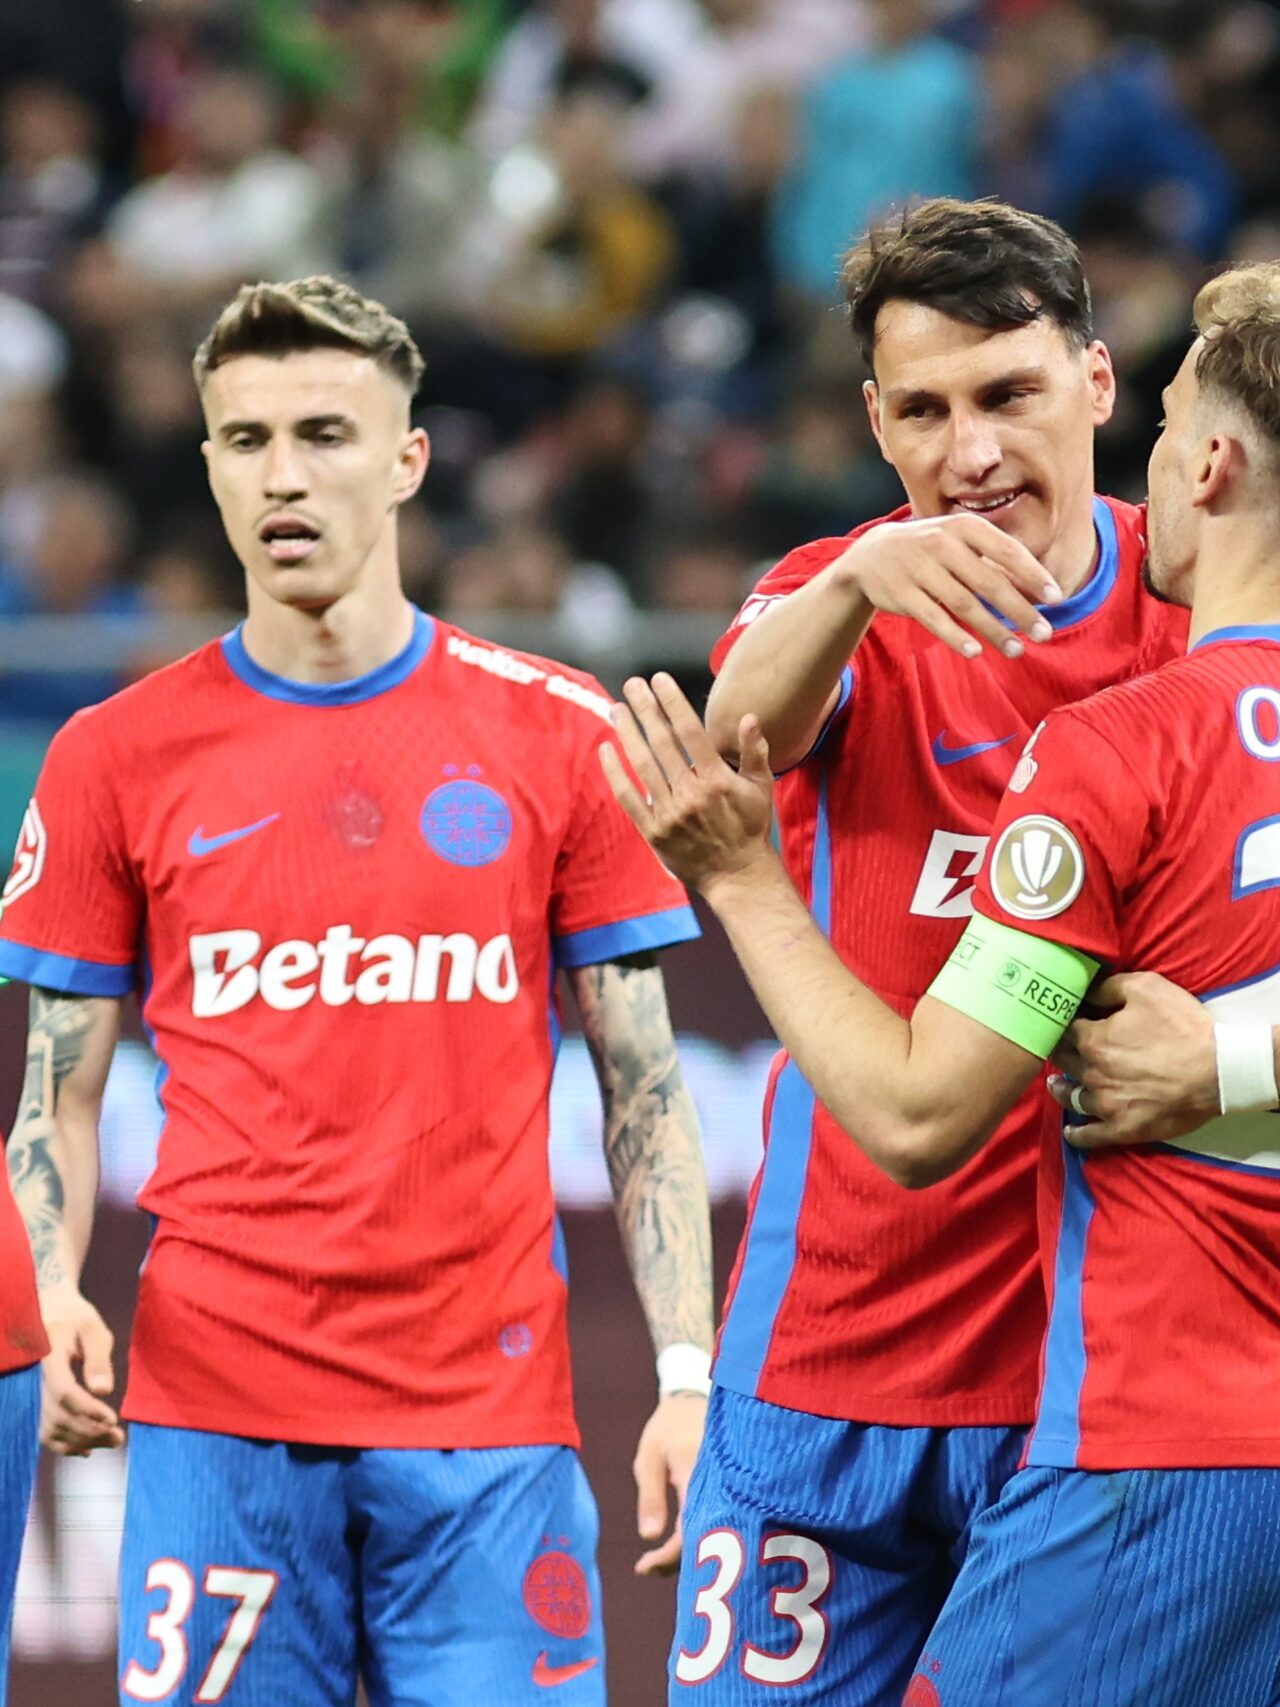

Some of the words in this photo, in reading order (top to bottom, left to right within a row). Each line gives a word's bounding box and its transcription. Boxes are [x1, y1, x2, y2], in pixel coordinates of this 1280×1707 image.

[189, 924, 520, 1018] Betano
[121, 1557, 280, 1704] 37
[674, 1526, 834, 1688] 33
